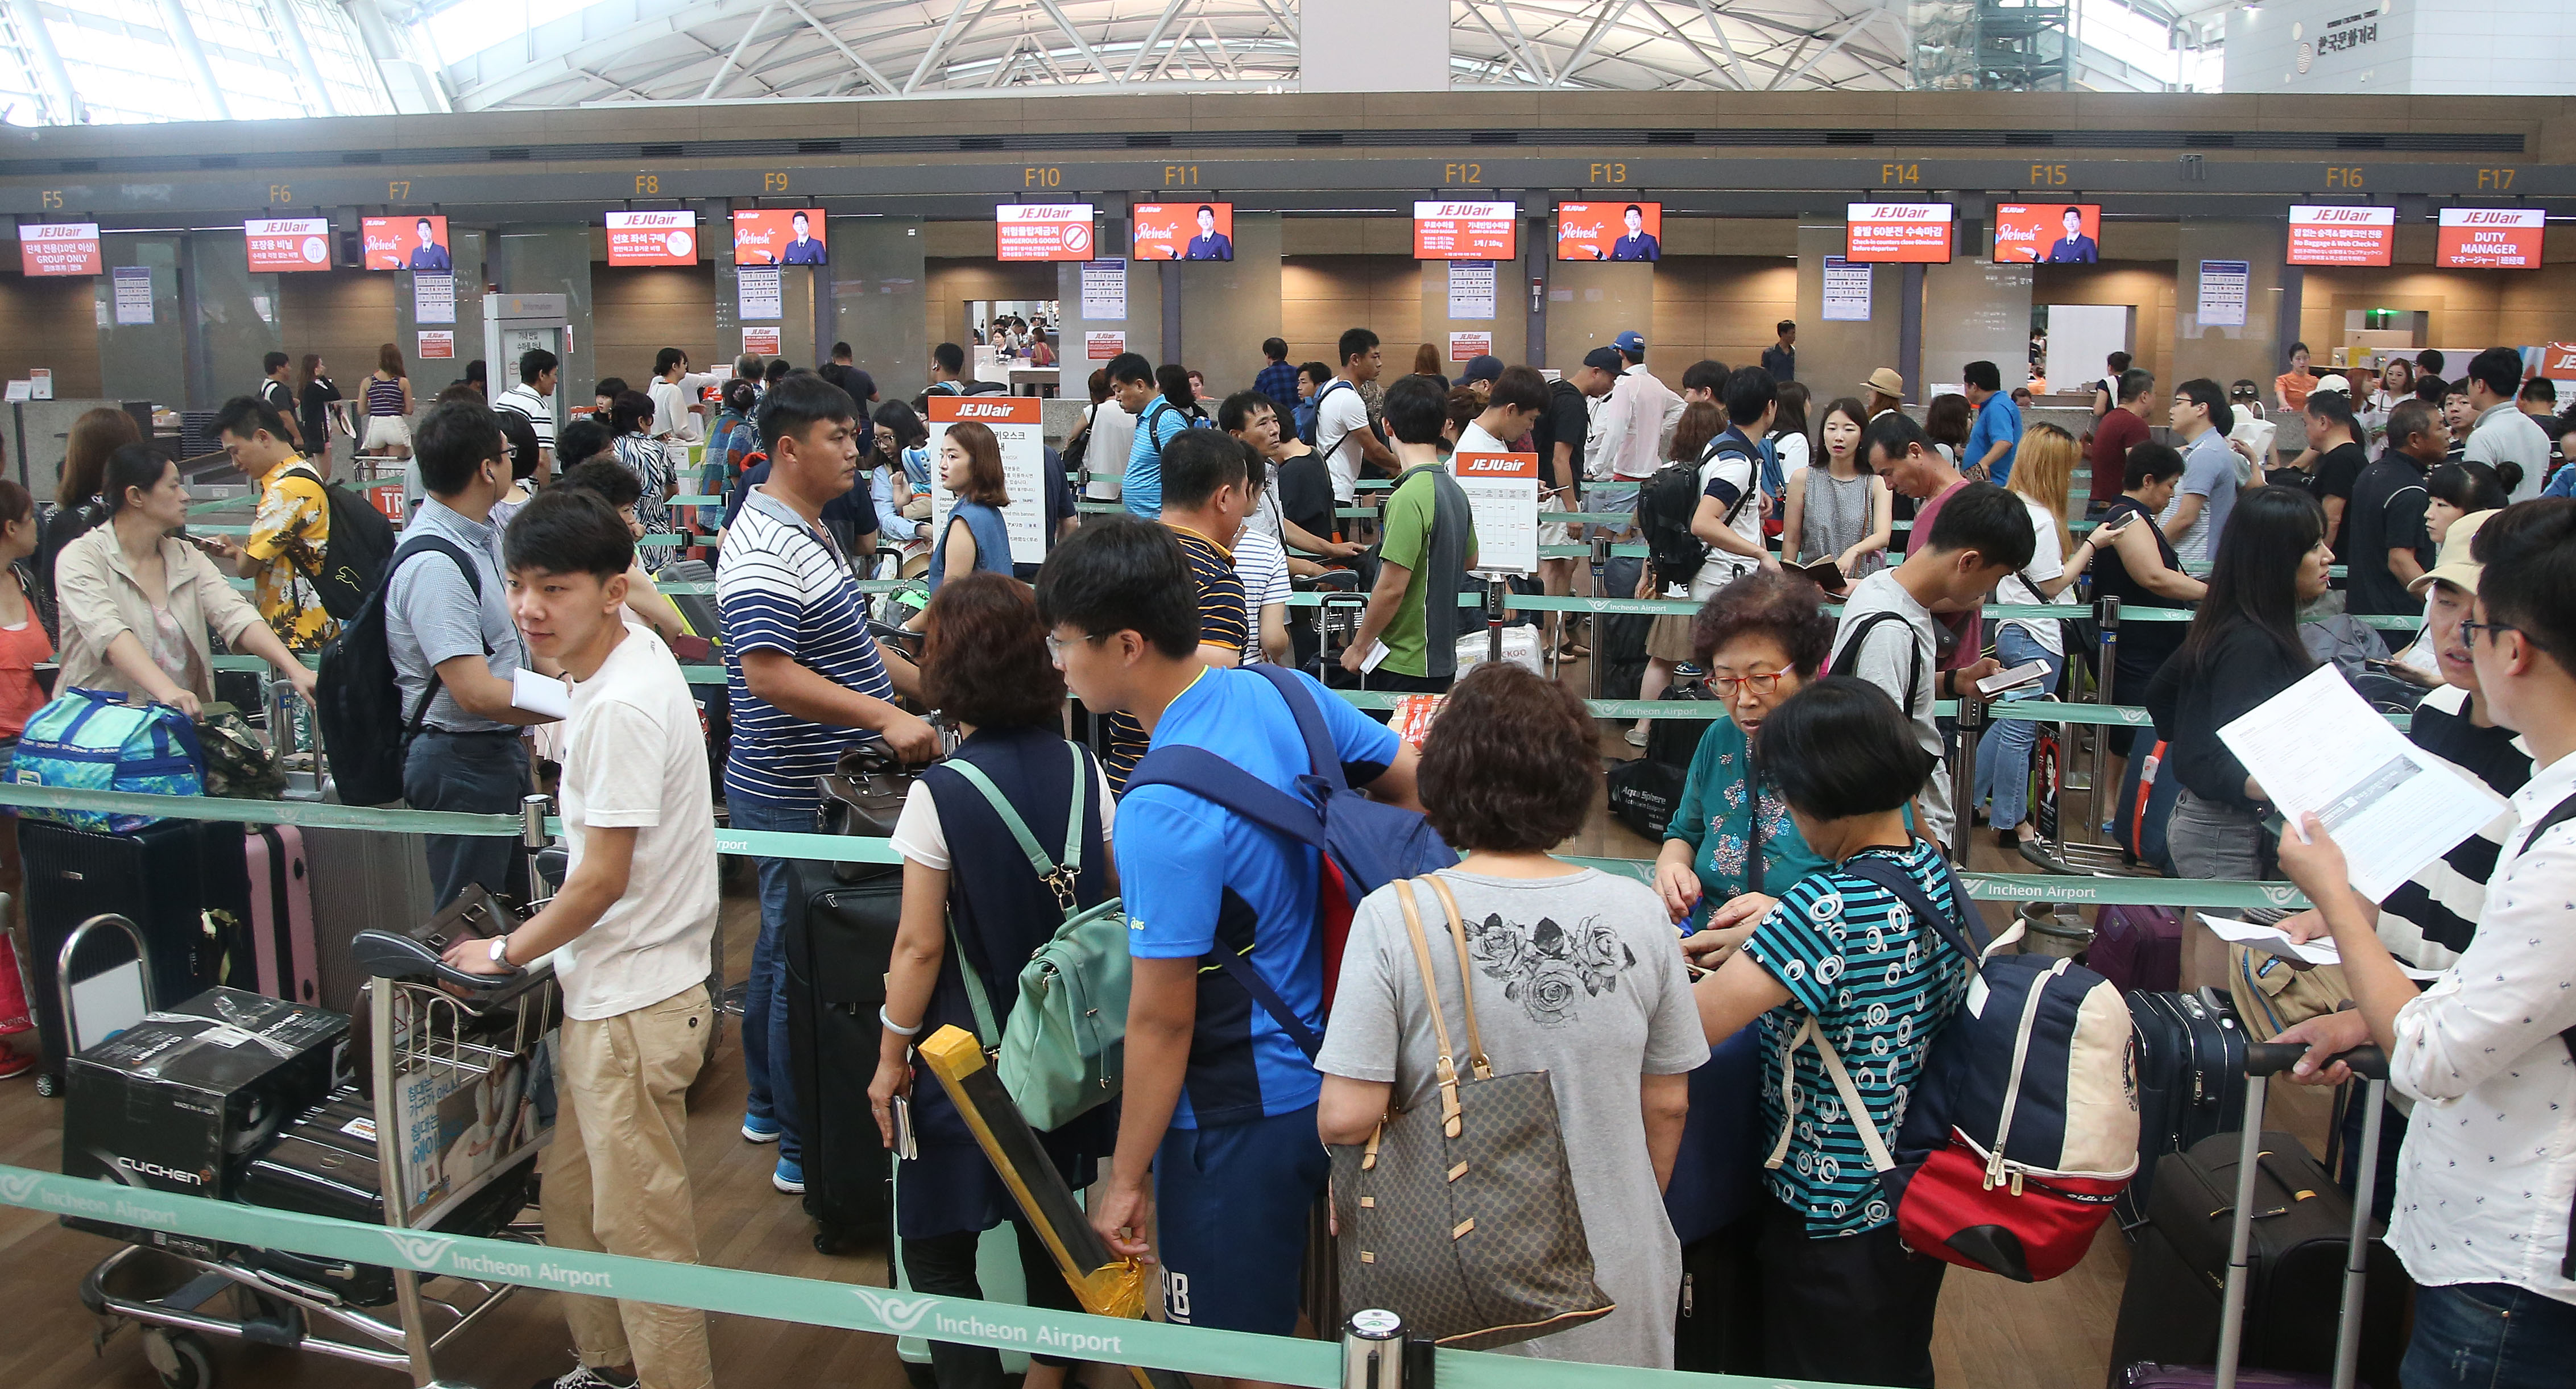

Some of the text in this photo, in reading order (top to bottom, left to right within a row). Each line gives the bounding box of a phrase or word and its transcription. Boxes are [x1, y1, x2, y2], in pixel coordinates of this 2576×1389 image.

[2317, 23, 2376, 56] 한국문화거리
[1025, 168, 1061, 187] F10
[1165, 166, 1198, 185] F11
[1446, 163, 1481, 183] F12
[1591, 163, 1626, 183] F13
[1883, 164, 1919, 184] F14
[2031, 165, 2068, 185] F15
[2326, 167, 2364, 188] F16
[2478, 169, 2515, 189] F17
[390, 182, 410, 199] F7
[636, 176, 659, 193] F8
[765, 173, 788, 191] F9
[42, 191, 63, 208] F5
[270, 185, 291, 202] F6
[1018, 207, 1072, 218] JEJUair
[1437, 205, 1494, 216] JEJUair
[1871, 206, 1930, 218] JEJUair
[2313, 209, 2372, 221] JEJUair
[2462, 212, 2523, 224] JEJUair
[263, 222, 310, 233] JEJUair
[624, 214, 678, 225] JEJUair
[38, 227, 82, 237] JEJUair
[612, 233, 666, 244] 선호 좌석 구매
[738, 228, 769, 245] Refresh
[1002, 226, 1059, 236] 위험물탑재금지
[1137, 222, 1173, 239] Refresh
[1562, 222, 1598, 239] Refresh
[1853, 226, 1943, 237] 출발 60분전 수속마감
[1999, 224, 2036, 241] Refresh
[2293, 228, 2383, 238] 짐 없는 전용
[2474, 232, 2505, 242] DUTY
[26, 242, 96, 254] 단체 전용(10인 이상)
[251, 239, 293, 250] 포장용 비닐
[367, 234, 397, 251] Refresh
[2461, 244, 2517, 254] MANAGER
[67, 254, 87, 263] ONLY
[955, 404, 1014, 417] JEJUair
[1468, 459, 1525, 472] JEJUair
[1664, 707, 1698, 717] Airport
[1622, 786, 1666, 805] Aqua Sphere
[1989, 883, 2096, 899] Incheon Airport
[41, 1188, 177, 1225] Incheon Airport
[452, 1252, 612, 1289] Incheon Airport
[935, 1313, 1121, 1354] Incheon Airport
